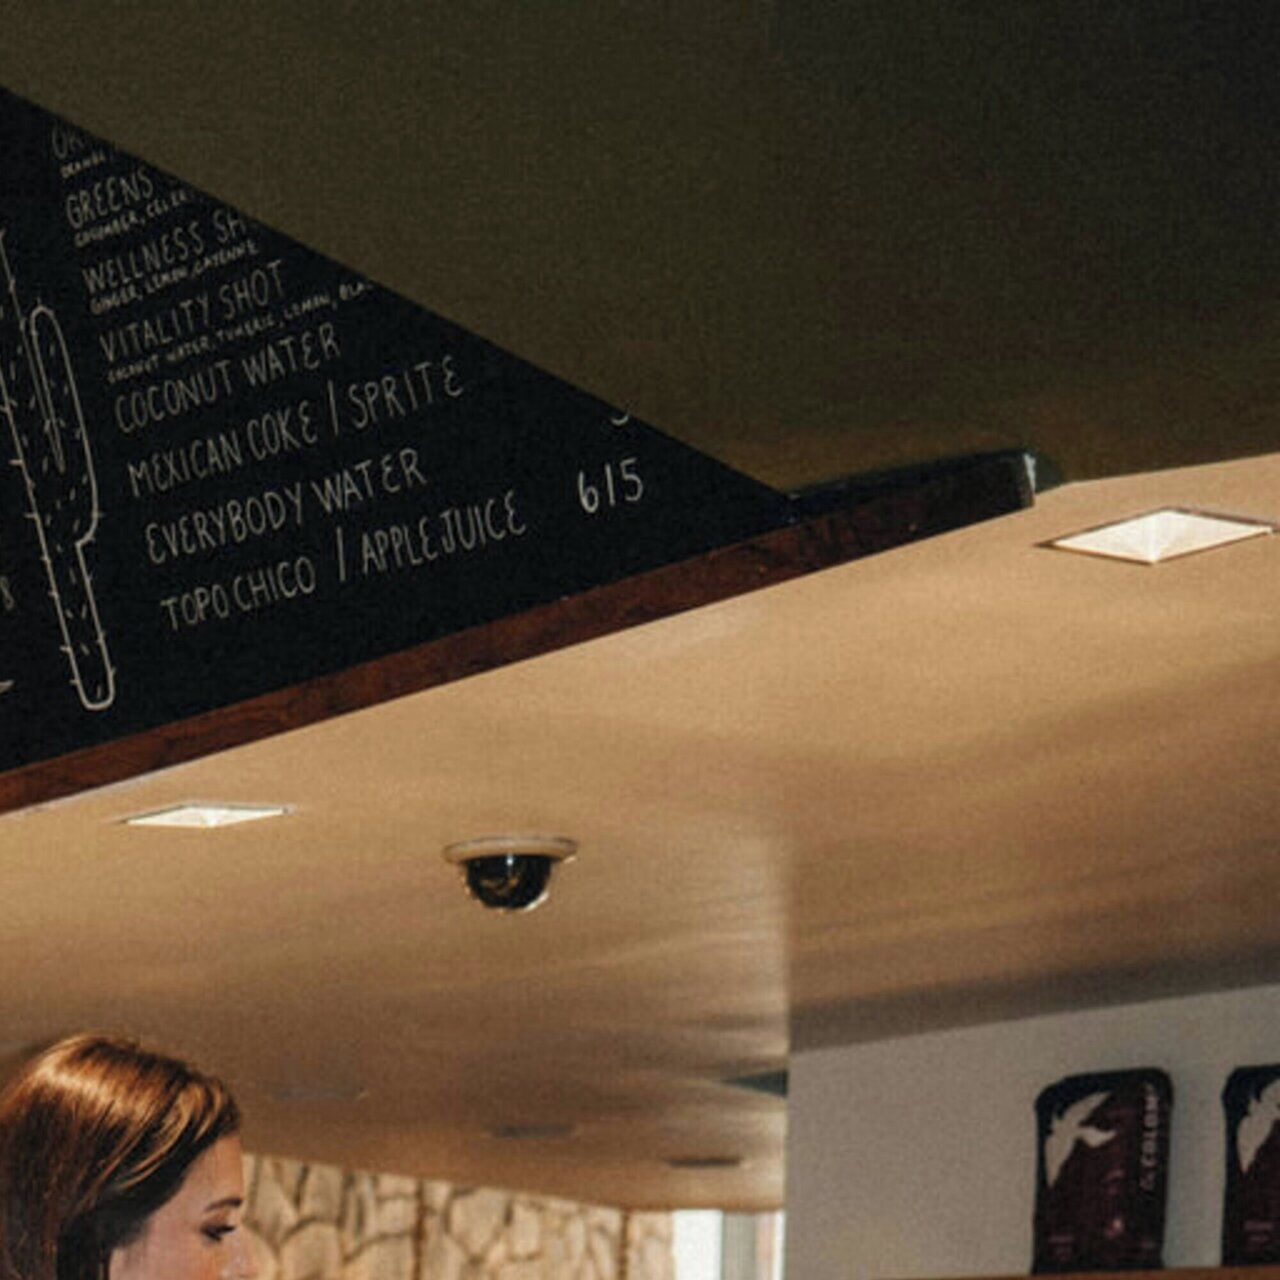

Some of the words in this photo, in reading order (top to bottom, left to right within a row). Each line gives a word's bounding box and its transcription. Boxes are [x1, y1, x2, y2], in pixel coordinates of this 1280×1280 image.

[66, 166, 154, 229] GREENS
[82, 220, 204, 294] WELLNESS
[213, 207, 246, 243] SH
[99, 292, 211, 362] VITALITY
[219, 259, 285, 321] SHOT
[114, 359, 232, 434] COCONUT
[241, 322, 342, 387] WATER
[127, 430, 243, 498] MEXICAN
[245, 401, 318, 461] COKE
[348, 355, 465, 430] SPRITE
[145, 482, 304, 565] EVERYBODY
[311, 448, 428, 514] WATER
[160, 583, 230, 631] TOPO
[232, 555, 317, 622] CHICO
[360, 514, 440, 574] APPLE
[439, 489, 527, 555] JUICE
